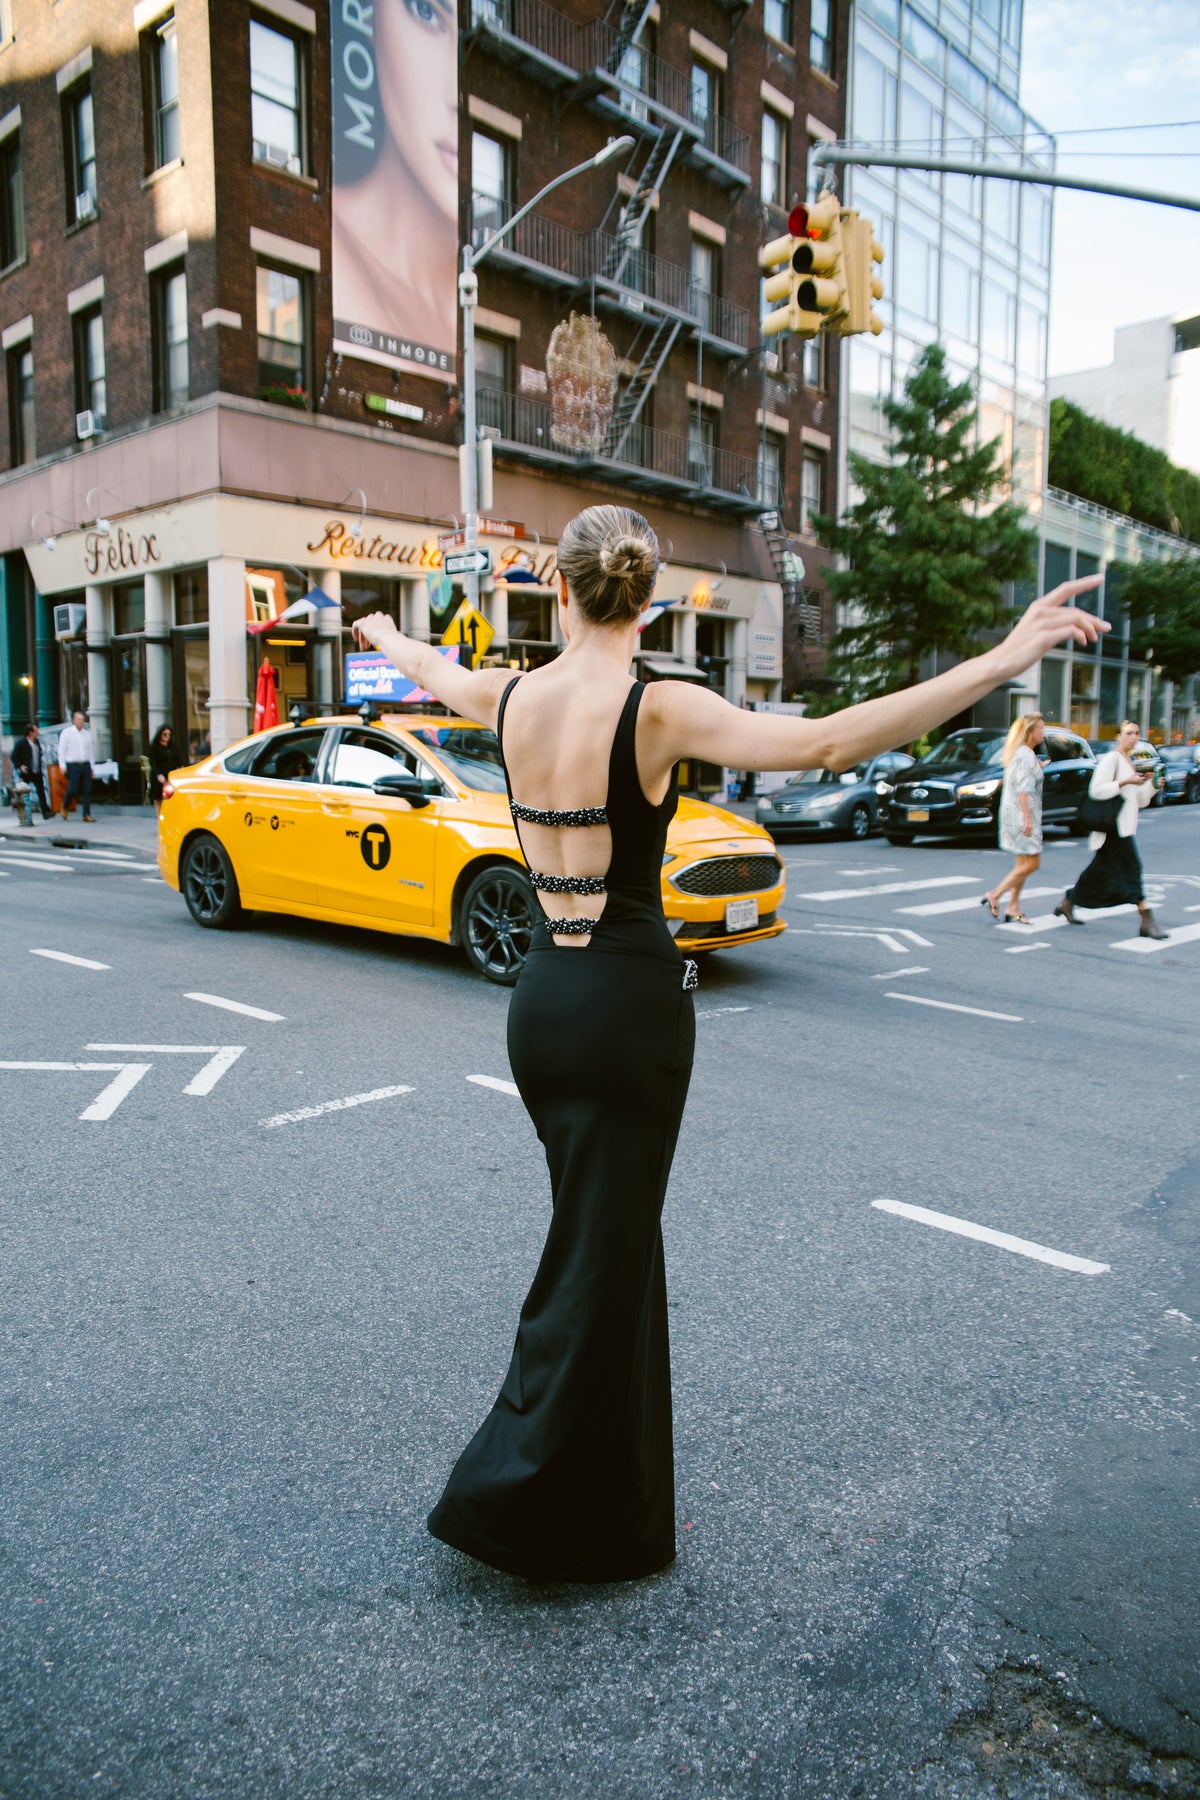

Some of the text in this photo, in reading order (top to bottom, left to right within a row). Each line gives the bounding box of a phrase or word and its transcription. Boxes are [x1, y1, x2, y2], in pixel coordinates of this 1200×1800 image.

[379, 335, 448, 369] INMODE
[306, 520, 444, 568] Restaura
[448, 557, 477, 569] ONE WAY
[349, 667, 379, 681] Official
[349, 682, 359, 696] of
[360, 682, 373, 695] the
[345, 830, 385, 865] NYC T
